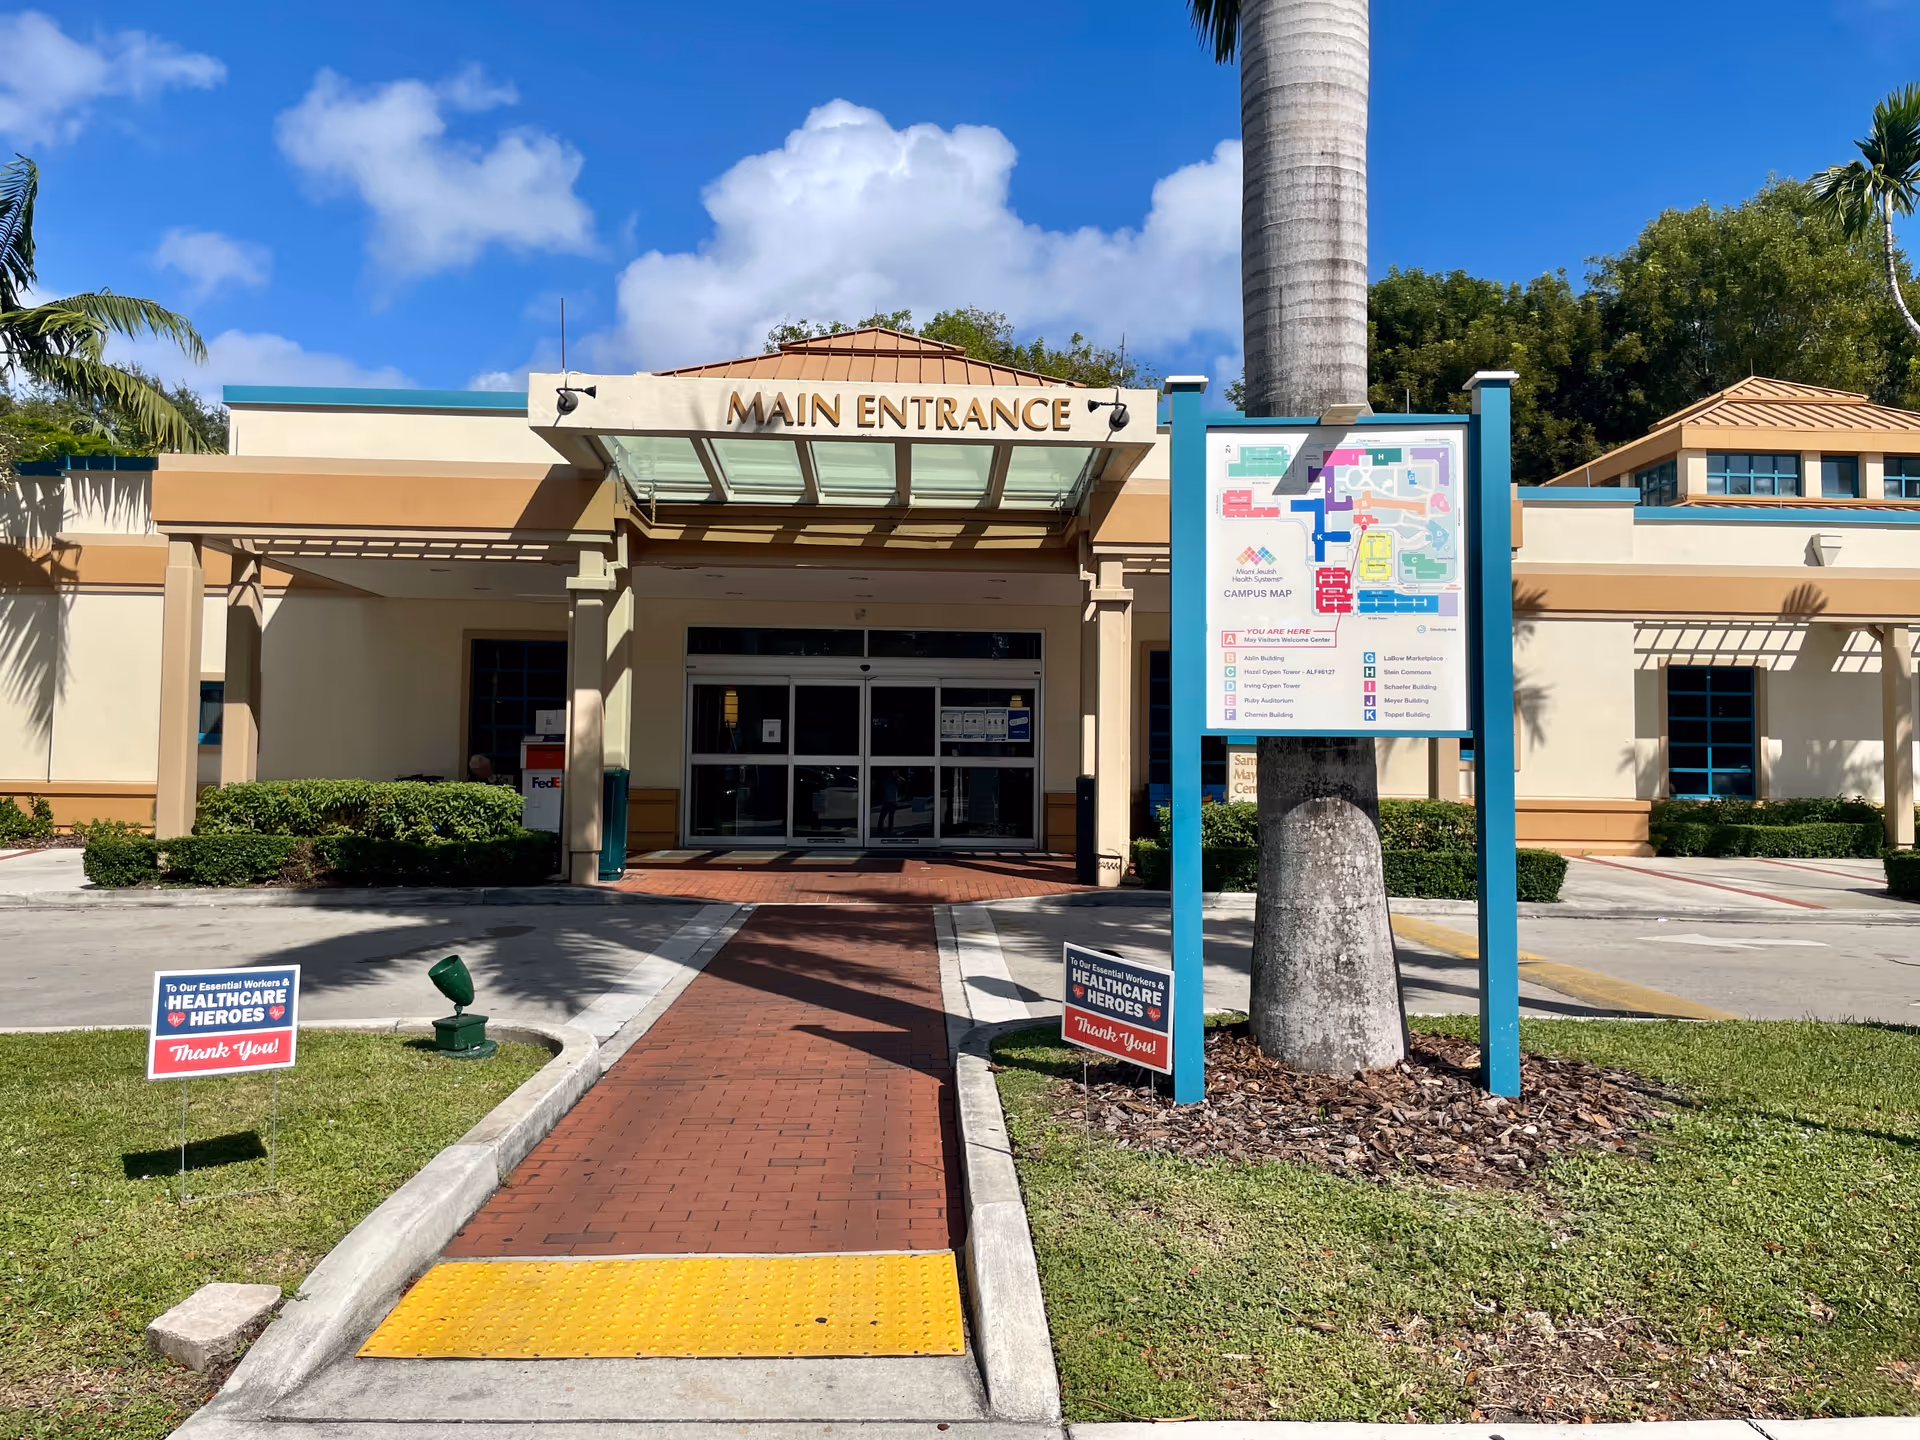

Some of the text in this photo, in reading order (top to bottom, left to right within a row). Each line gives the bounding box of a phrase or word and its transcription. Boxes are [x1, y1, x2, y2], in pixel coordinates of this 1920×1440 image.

[727, 391, 1072, 432] MAIN ENTRANCE
[1378, 453, 1384, 461] H
[1317, 533, 1323, 541] K
[1223, 589, 1292, 598] CAMPUS MAP
[1226, 634, 1234, 644] A
[1365, 653, 1374, 663] G
[1226, 667, 1234, 677] C
[1366, 667, 1374, 677] H
[1226, 682, 1234, 691] D
[1226, 710, 1234, 719] F
[1366, 710, 1375, 720] K
[1234, 755, 1257, 766] Sam
[1234, 768, 1257, 783] May
[1070, 956, 1165, 991] To Our Essential Workers &
[165, 977, 290, 993] To Our Essential Workers &
[1072, 968, 1162, 1007] HEALTHCARE
[168, 988, 287, 1010] HEALTHCARE
[1087, 989, 1144, 1018] HEROES
[189, 1007, 265, 1027] HEROES
[1074, 1015, 1156, 1055] Thank You!
[169, 1037, 279, 1062] Thank You!
